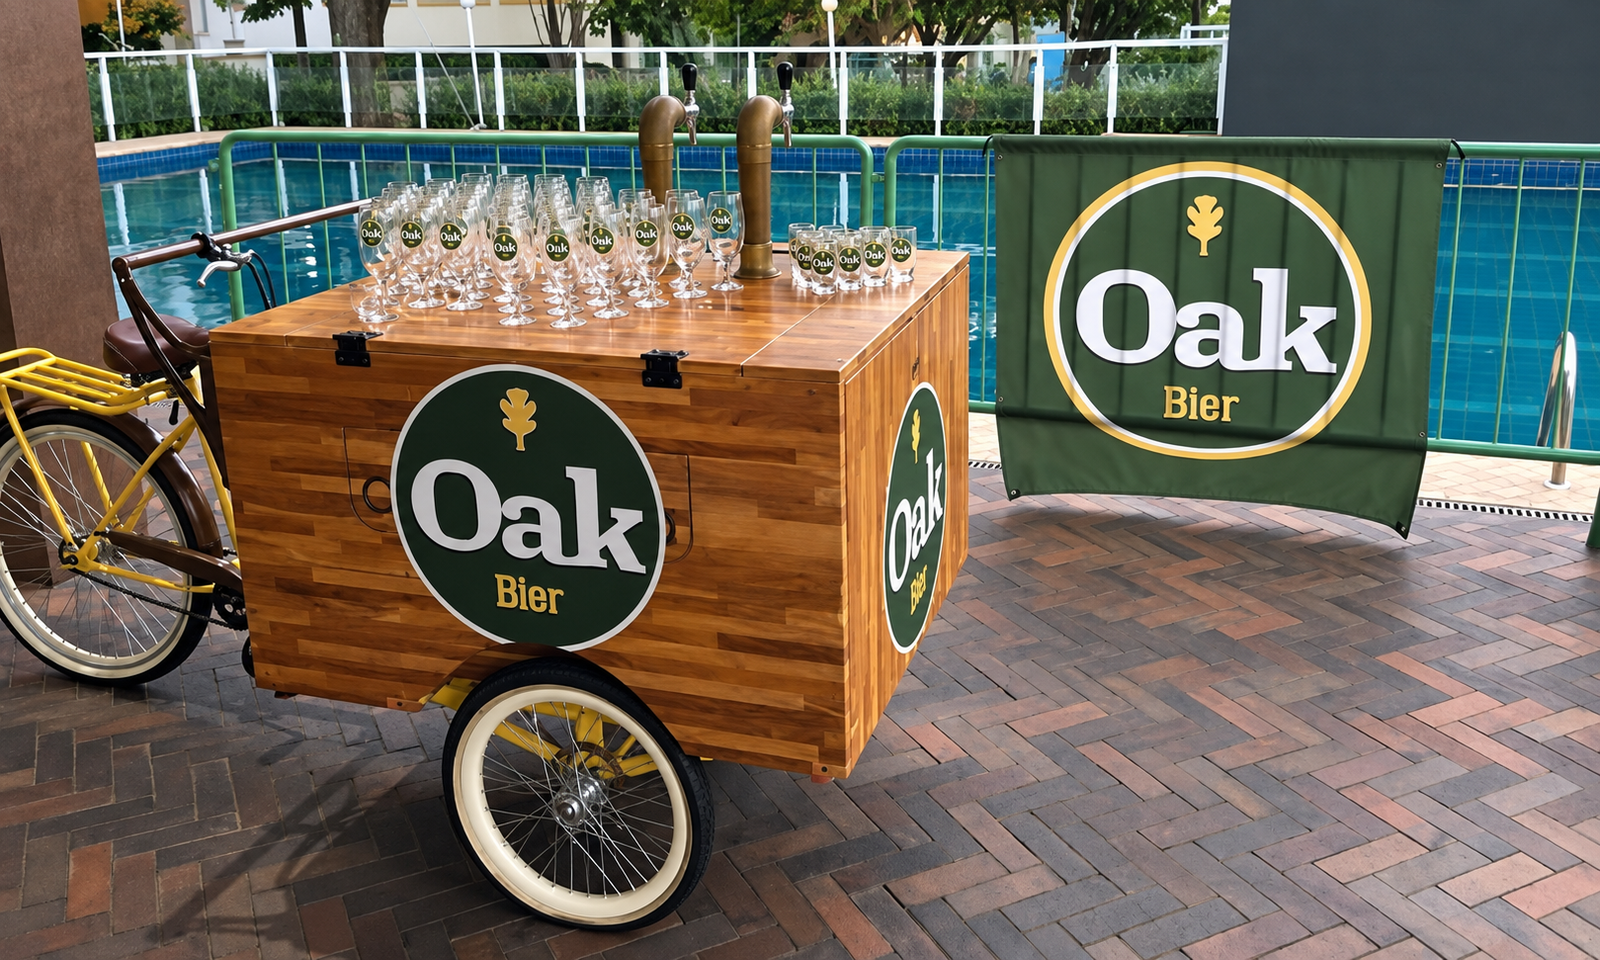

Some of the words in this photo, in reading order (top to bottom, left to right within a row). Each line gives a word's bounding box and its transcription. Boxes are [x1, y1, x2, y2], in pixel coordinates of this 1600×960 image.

[1076, 267, 1337, 374] Oak
[1163, 385, 1240, 422] Bier
[411, 458, 646, 574] Oak
[889, 448, 943, 592] Oak
[494, 573, 564, 614] Bier
[910, 564, 928, 616] Bier
